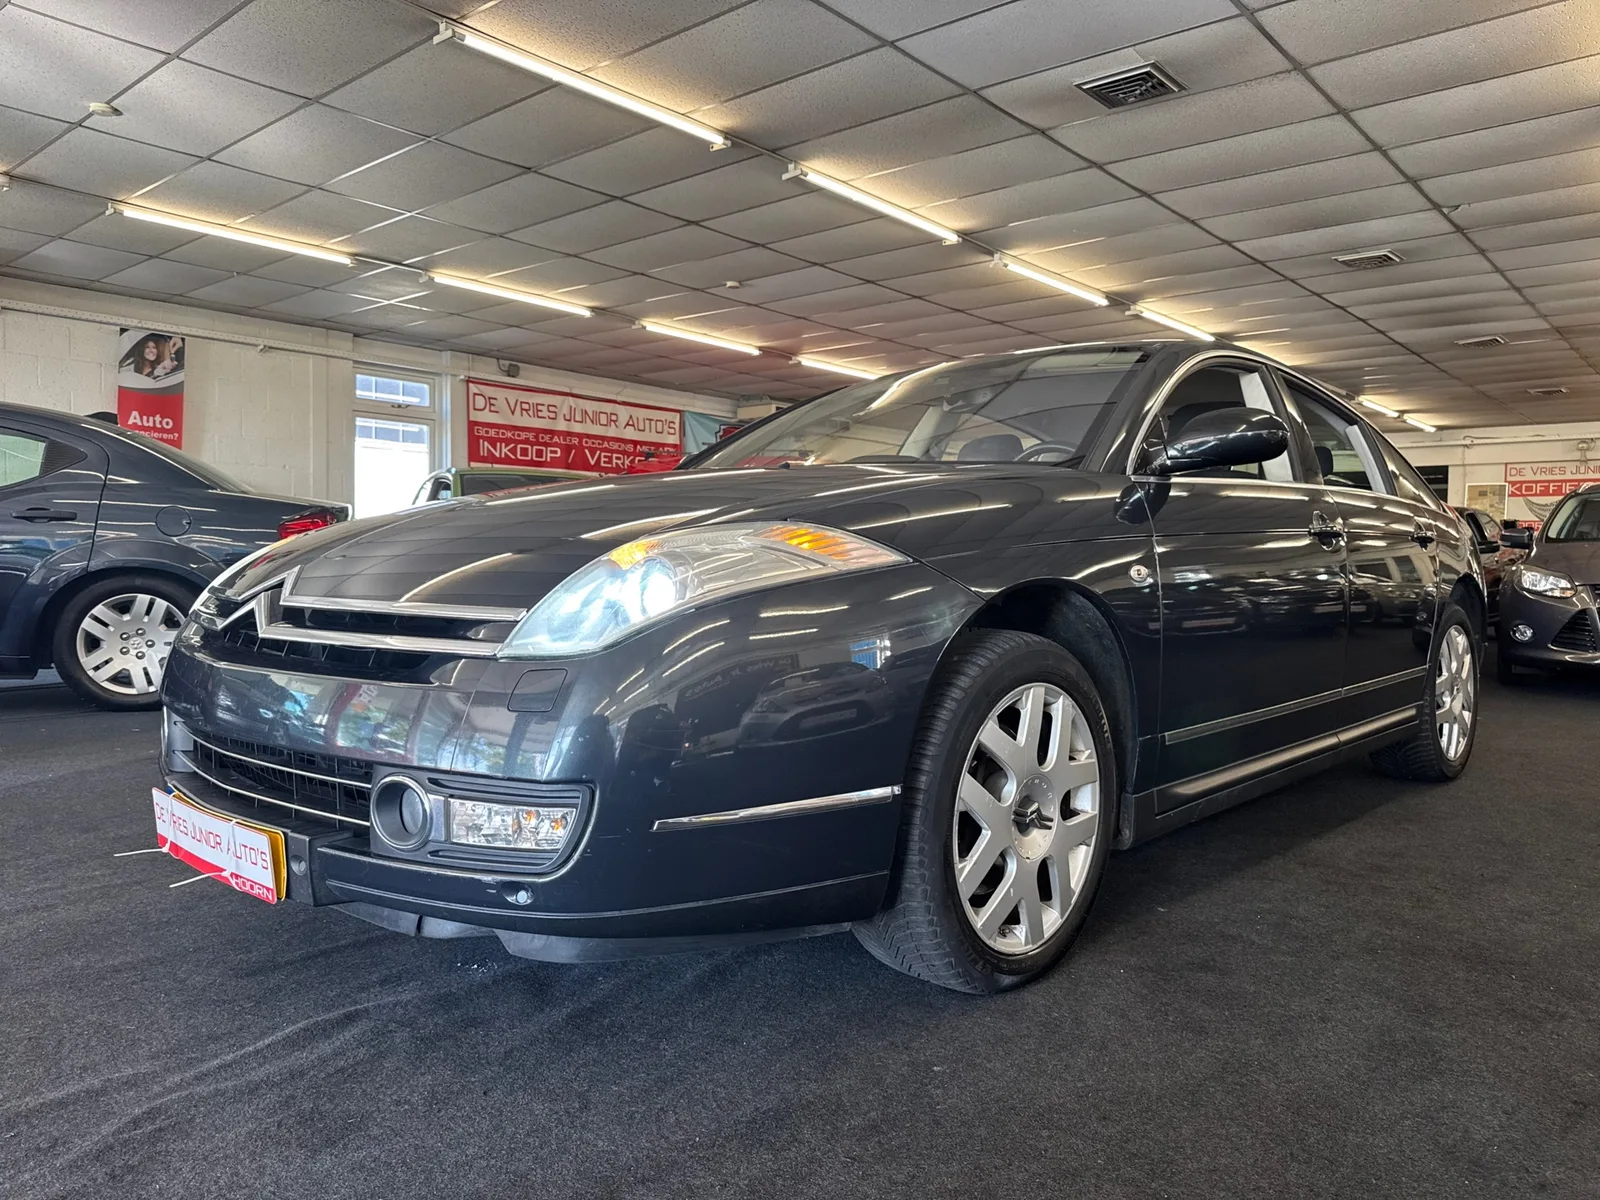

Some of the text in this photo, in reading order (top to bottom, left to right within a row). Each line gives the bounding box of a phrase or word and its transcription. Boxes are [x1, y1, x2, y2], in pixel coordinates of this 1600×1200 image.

[127, 410, 173, 429] Auto
[473, 393, 677, 436] DE VRIES JUNIOR AUTO'S
[474, 426, 536, 441] GOEDKOPE
[539, 434, 579, 446] DEALER
[582, 438, 634, 452] OCCASIONS
[479, 439, 561, 462] INKOOP
[585, 449, 655, 469] VERK
[1509, 467, 1526, 477] DE
[1530, 466, 1566, 476] VRIES
[1509, 482, 1583, 495] KOFFIE
[155, 802, 166, 824] DE
[191, 822, 223, 853] JUNIOR
[232, 874, 273, 901] HOORN
